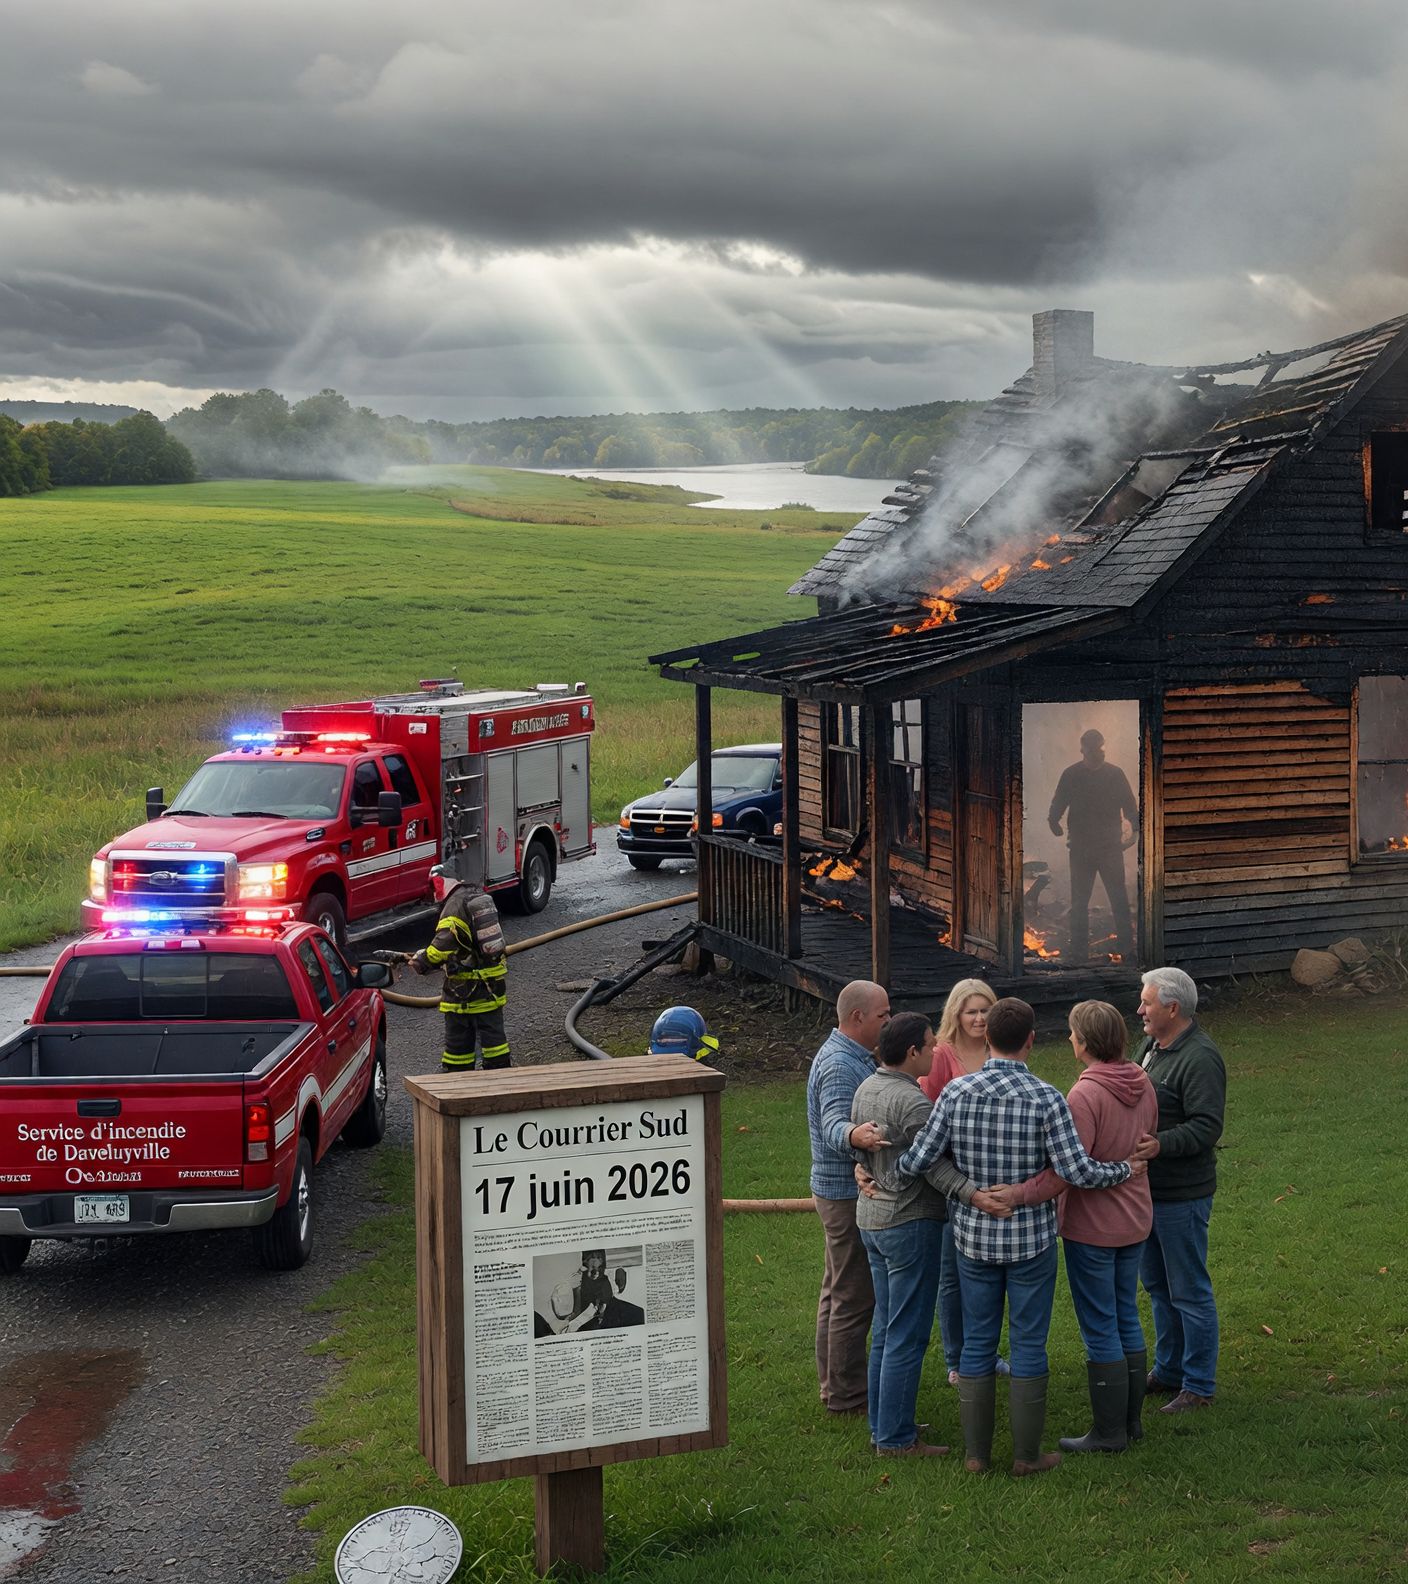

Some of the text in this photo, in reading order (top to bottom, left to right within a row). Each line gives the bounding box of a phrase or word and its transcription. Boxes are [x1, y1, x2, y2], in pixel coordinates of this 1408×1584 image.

[17, 1122, 187, 1141] Service d'incendie
[473, 1108, 689, 1154] Le Courrier Sud
[36, 1142, 171, 1164] de Daveluyville
[475, 1158, 691, 1220] 17 juin 2026
